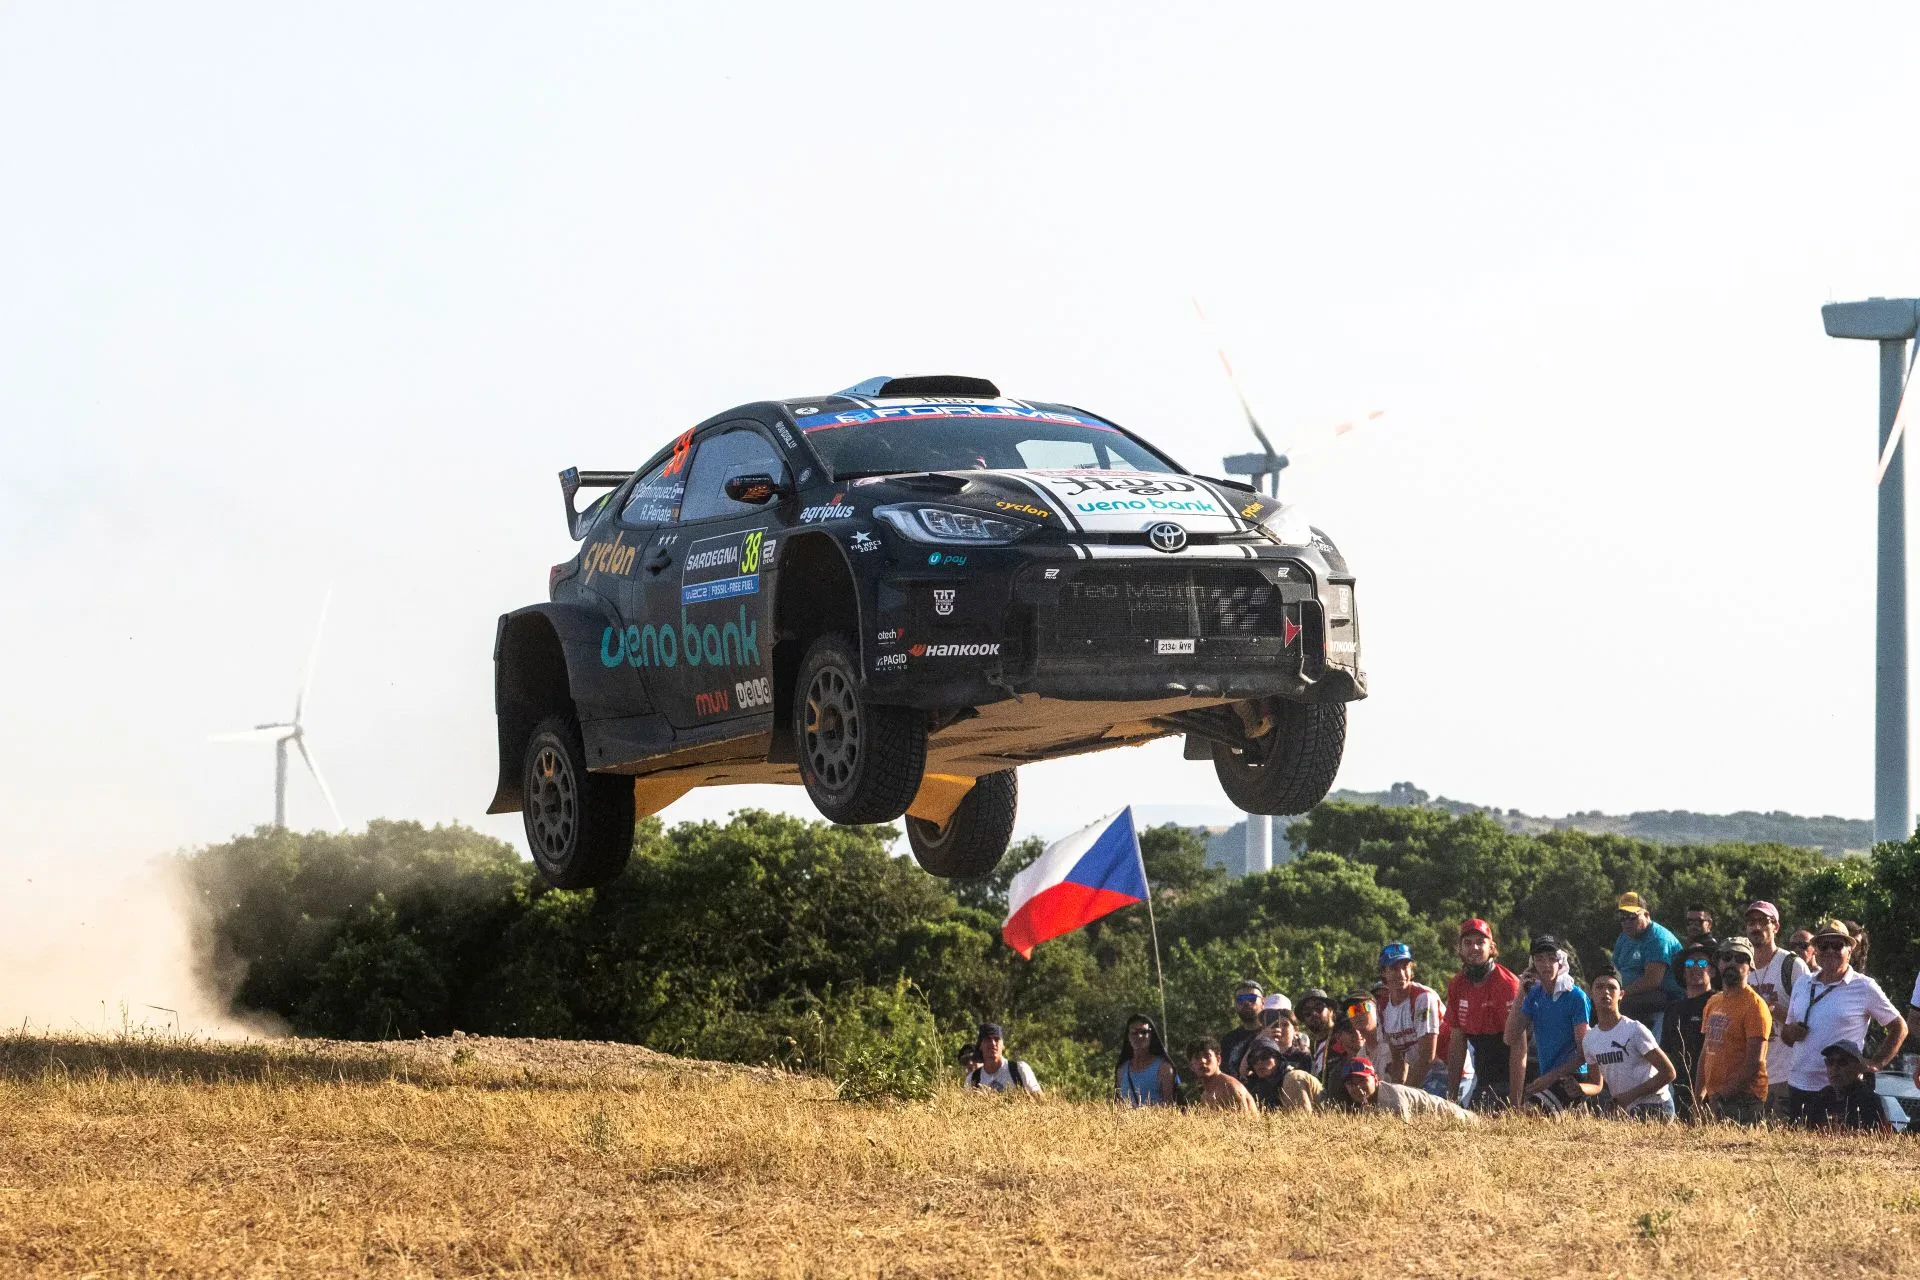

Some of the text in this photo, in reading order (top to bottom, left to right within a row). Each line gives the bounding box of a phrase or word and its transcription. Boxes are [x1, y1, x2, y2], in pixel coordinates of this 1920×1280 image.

[799, 502, 855, 523] agriplus
[995, 501, 1049, 518] cyclon
[1077, 497, 1216, 513] ueno bank
[584, 530, 636, 585] cyclon
[686, 545, 738, 571] SARDEGNA
[741, 531, 763, 573] 38
[943, 555, 967, 566] pay
[741, 579, 754, 591] FUEL
[600, 604, 760, 668] ueno bank
[1160, 643, 1176, 651] 2134
[883, 653, 907, 666] PAGID
[1595, 1051, 1624, 1065] PUMA
